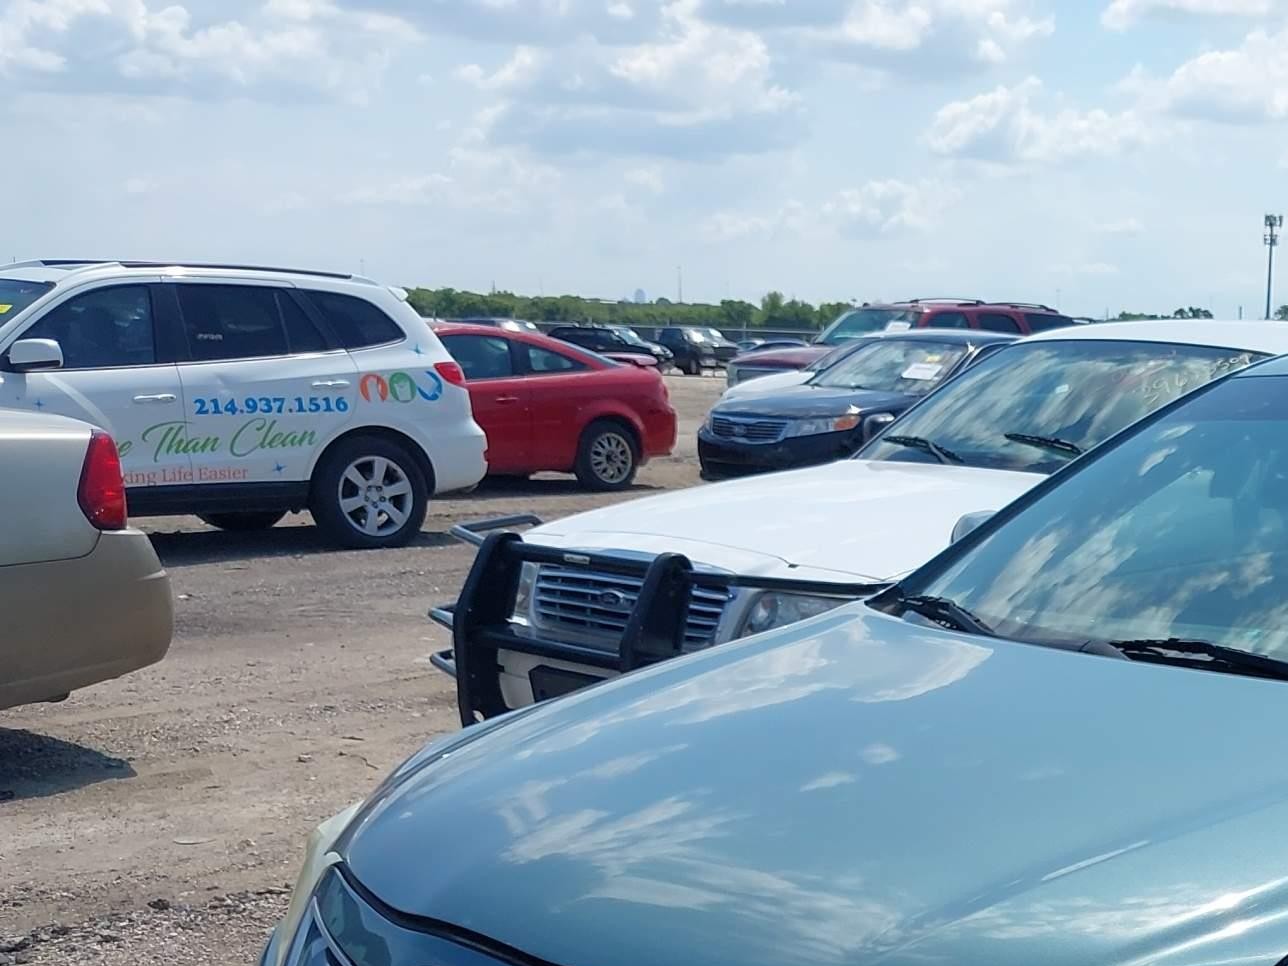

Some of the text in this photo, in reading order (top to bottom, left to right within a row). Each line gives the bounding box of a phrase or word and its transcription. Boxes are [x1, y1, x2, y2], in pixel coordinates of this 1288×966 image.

[194, 397, 349, 415] 214.937.1516
[142, 421, 219, 463] Than
[230, 417, 317, 457] Clean
[162, 466, 193, 482] Life
[199, 465, 249, 481] Easier
